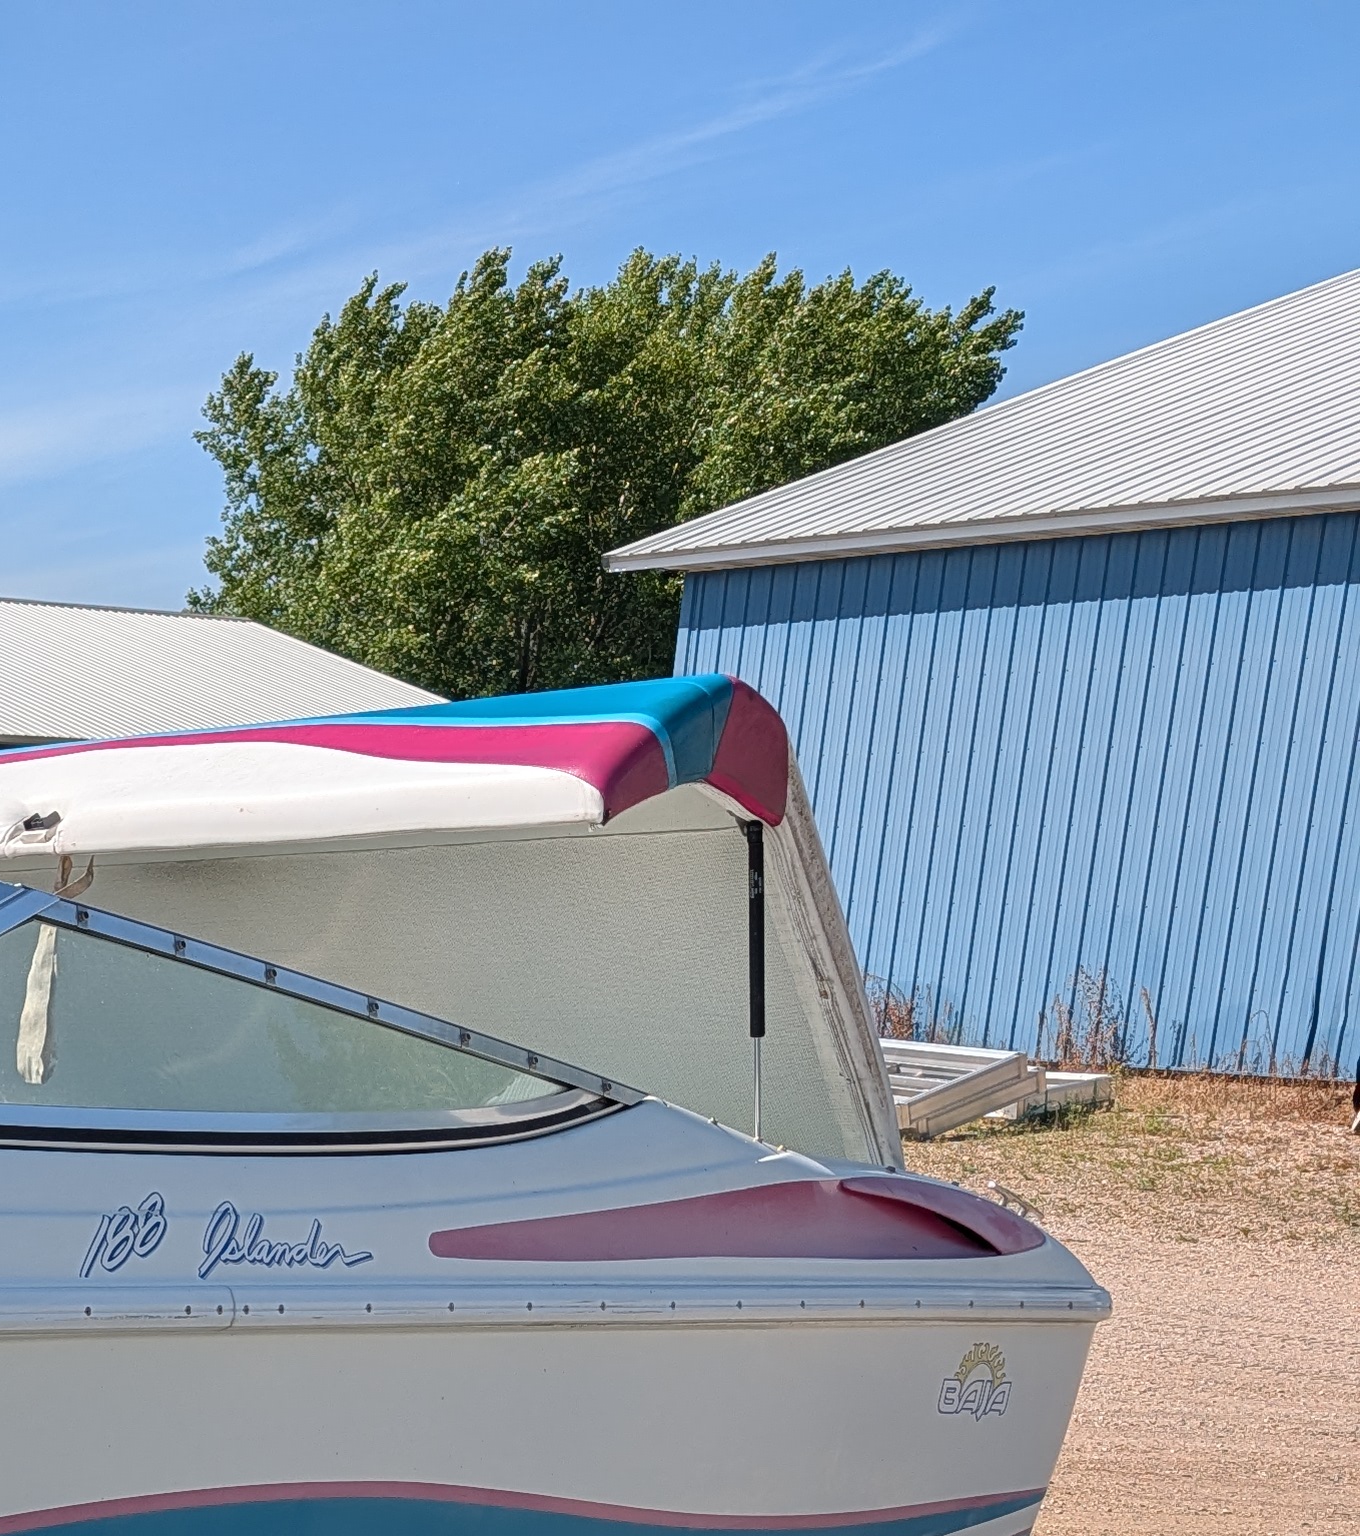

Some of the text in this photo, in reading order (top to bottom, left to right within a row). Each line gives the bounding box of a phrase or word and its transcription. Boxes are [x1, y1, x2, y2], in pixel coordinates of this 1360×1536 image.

[79, 1191, 374, 1280] 188 Islander
[937, 1378, 1012, 1422] BAJA
